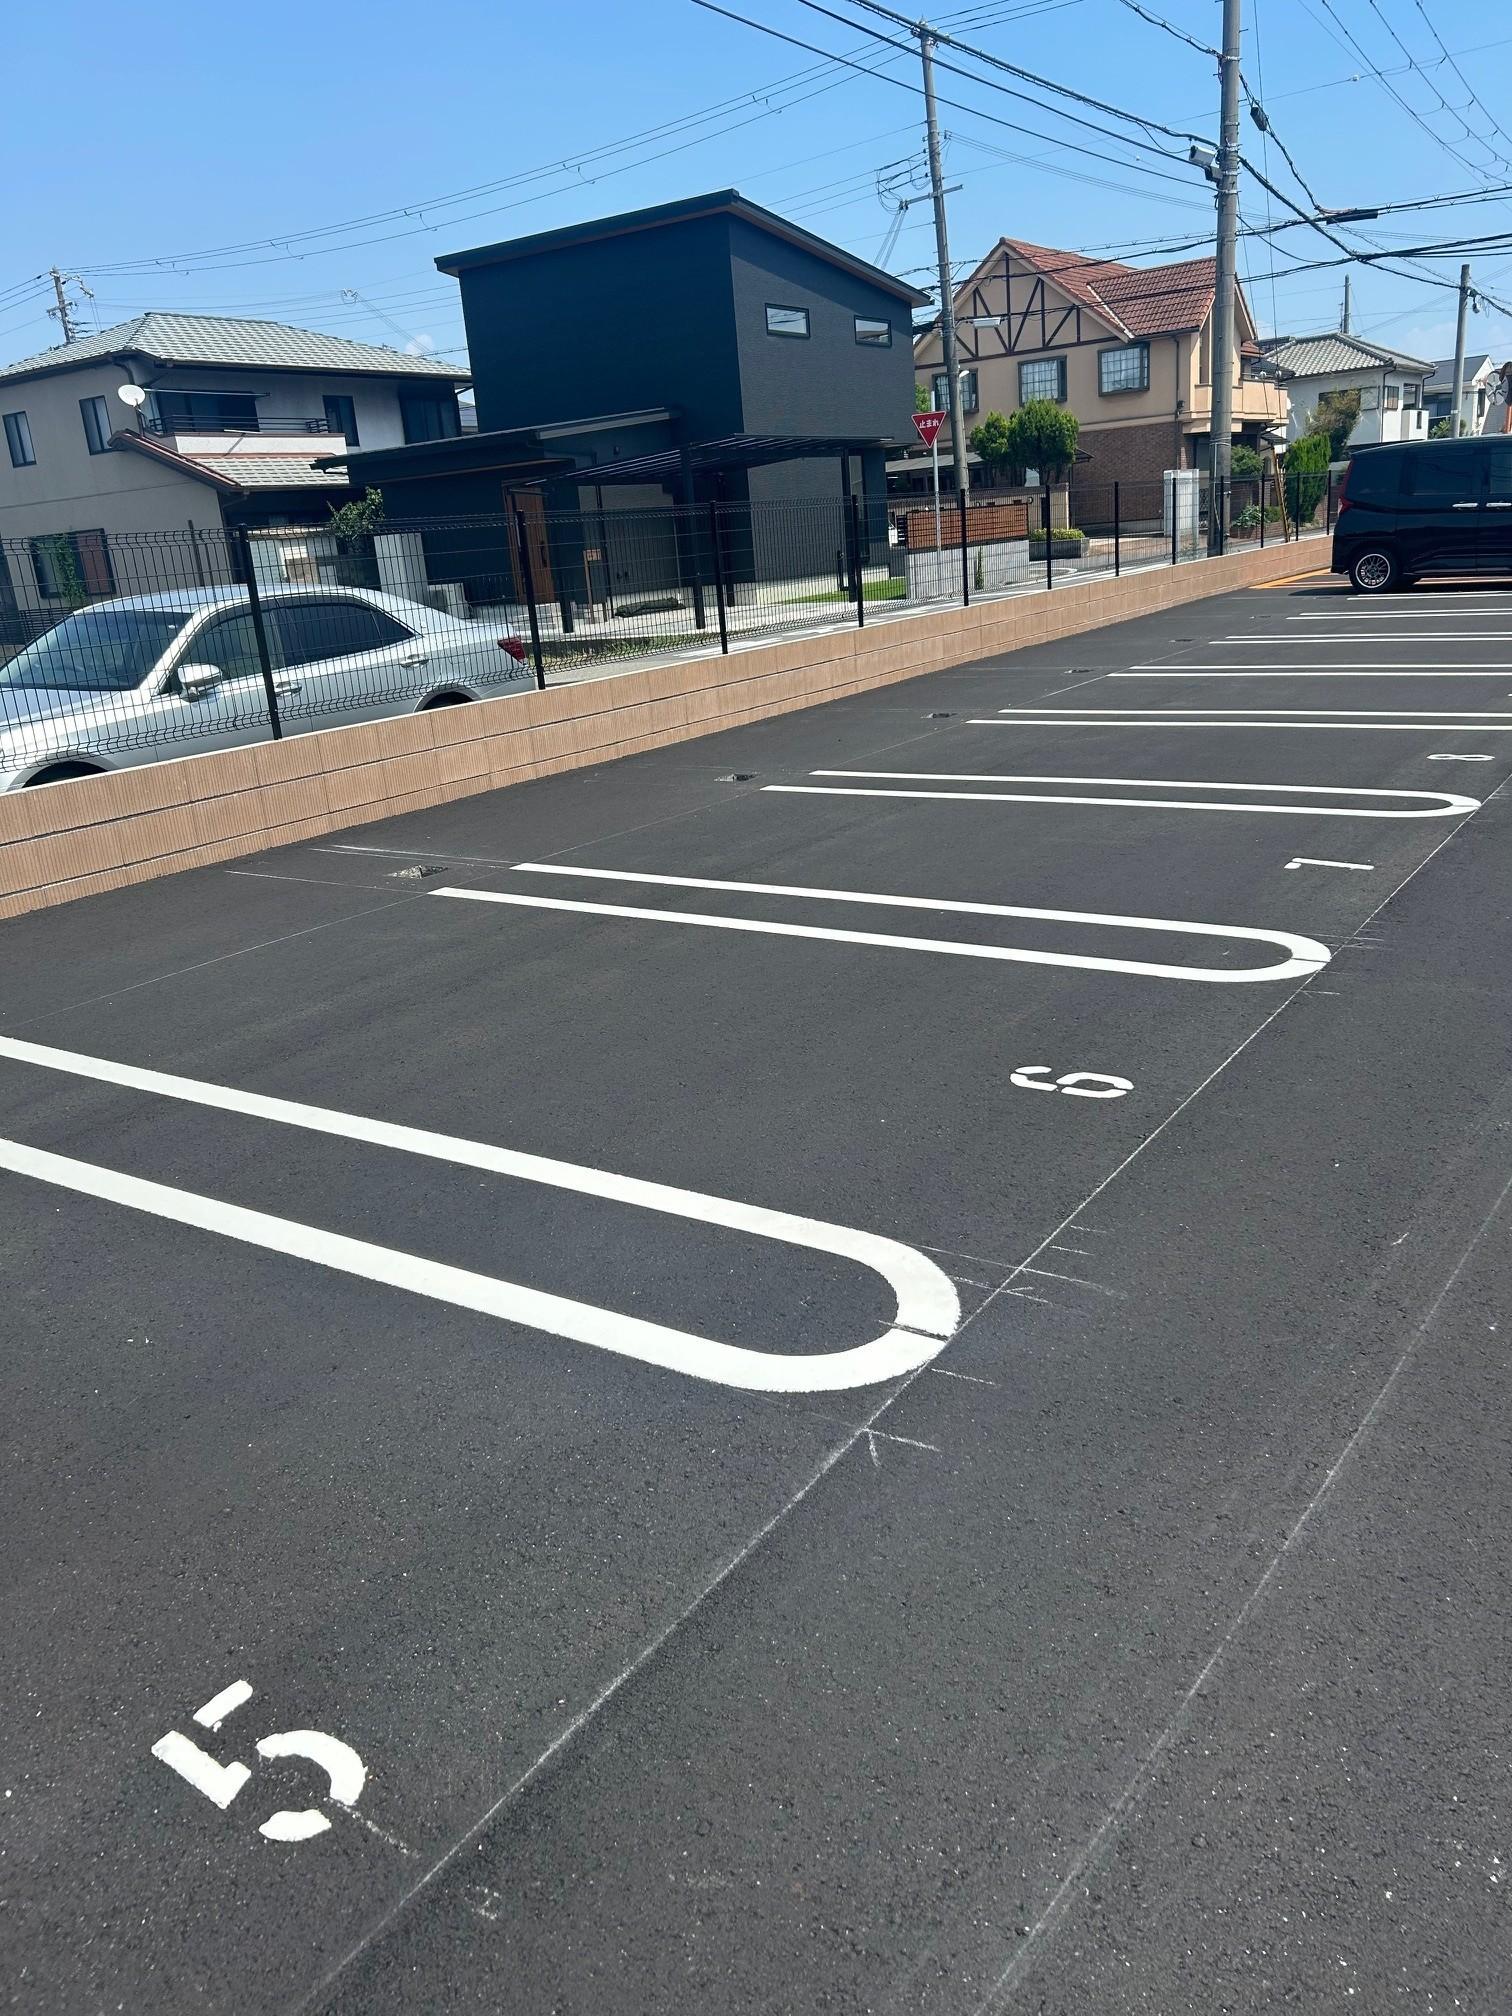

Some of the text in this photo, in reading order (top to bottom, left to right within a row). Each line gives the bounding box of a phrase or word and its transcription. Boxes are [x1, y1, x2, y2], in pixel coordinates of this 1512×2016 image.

[919, 419, 939, 429] 止まれ
[1426, 753, 1495, 761] 8
[1010, 1066, 1134, 1098] 6
[151, 1679, 367, 1841] 5
